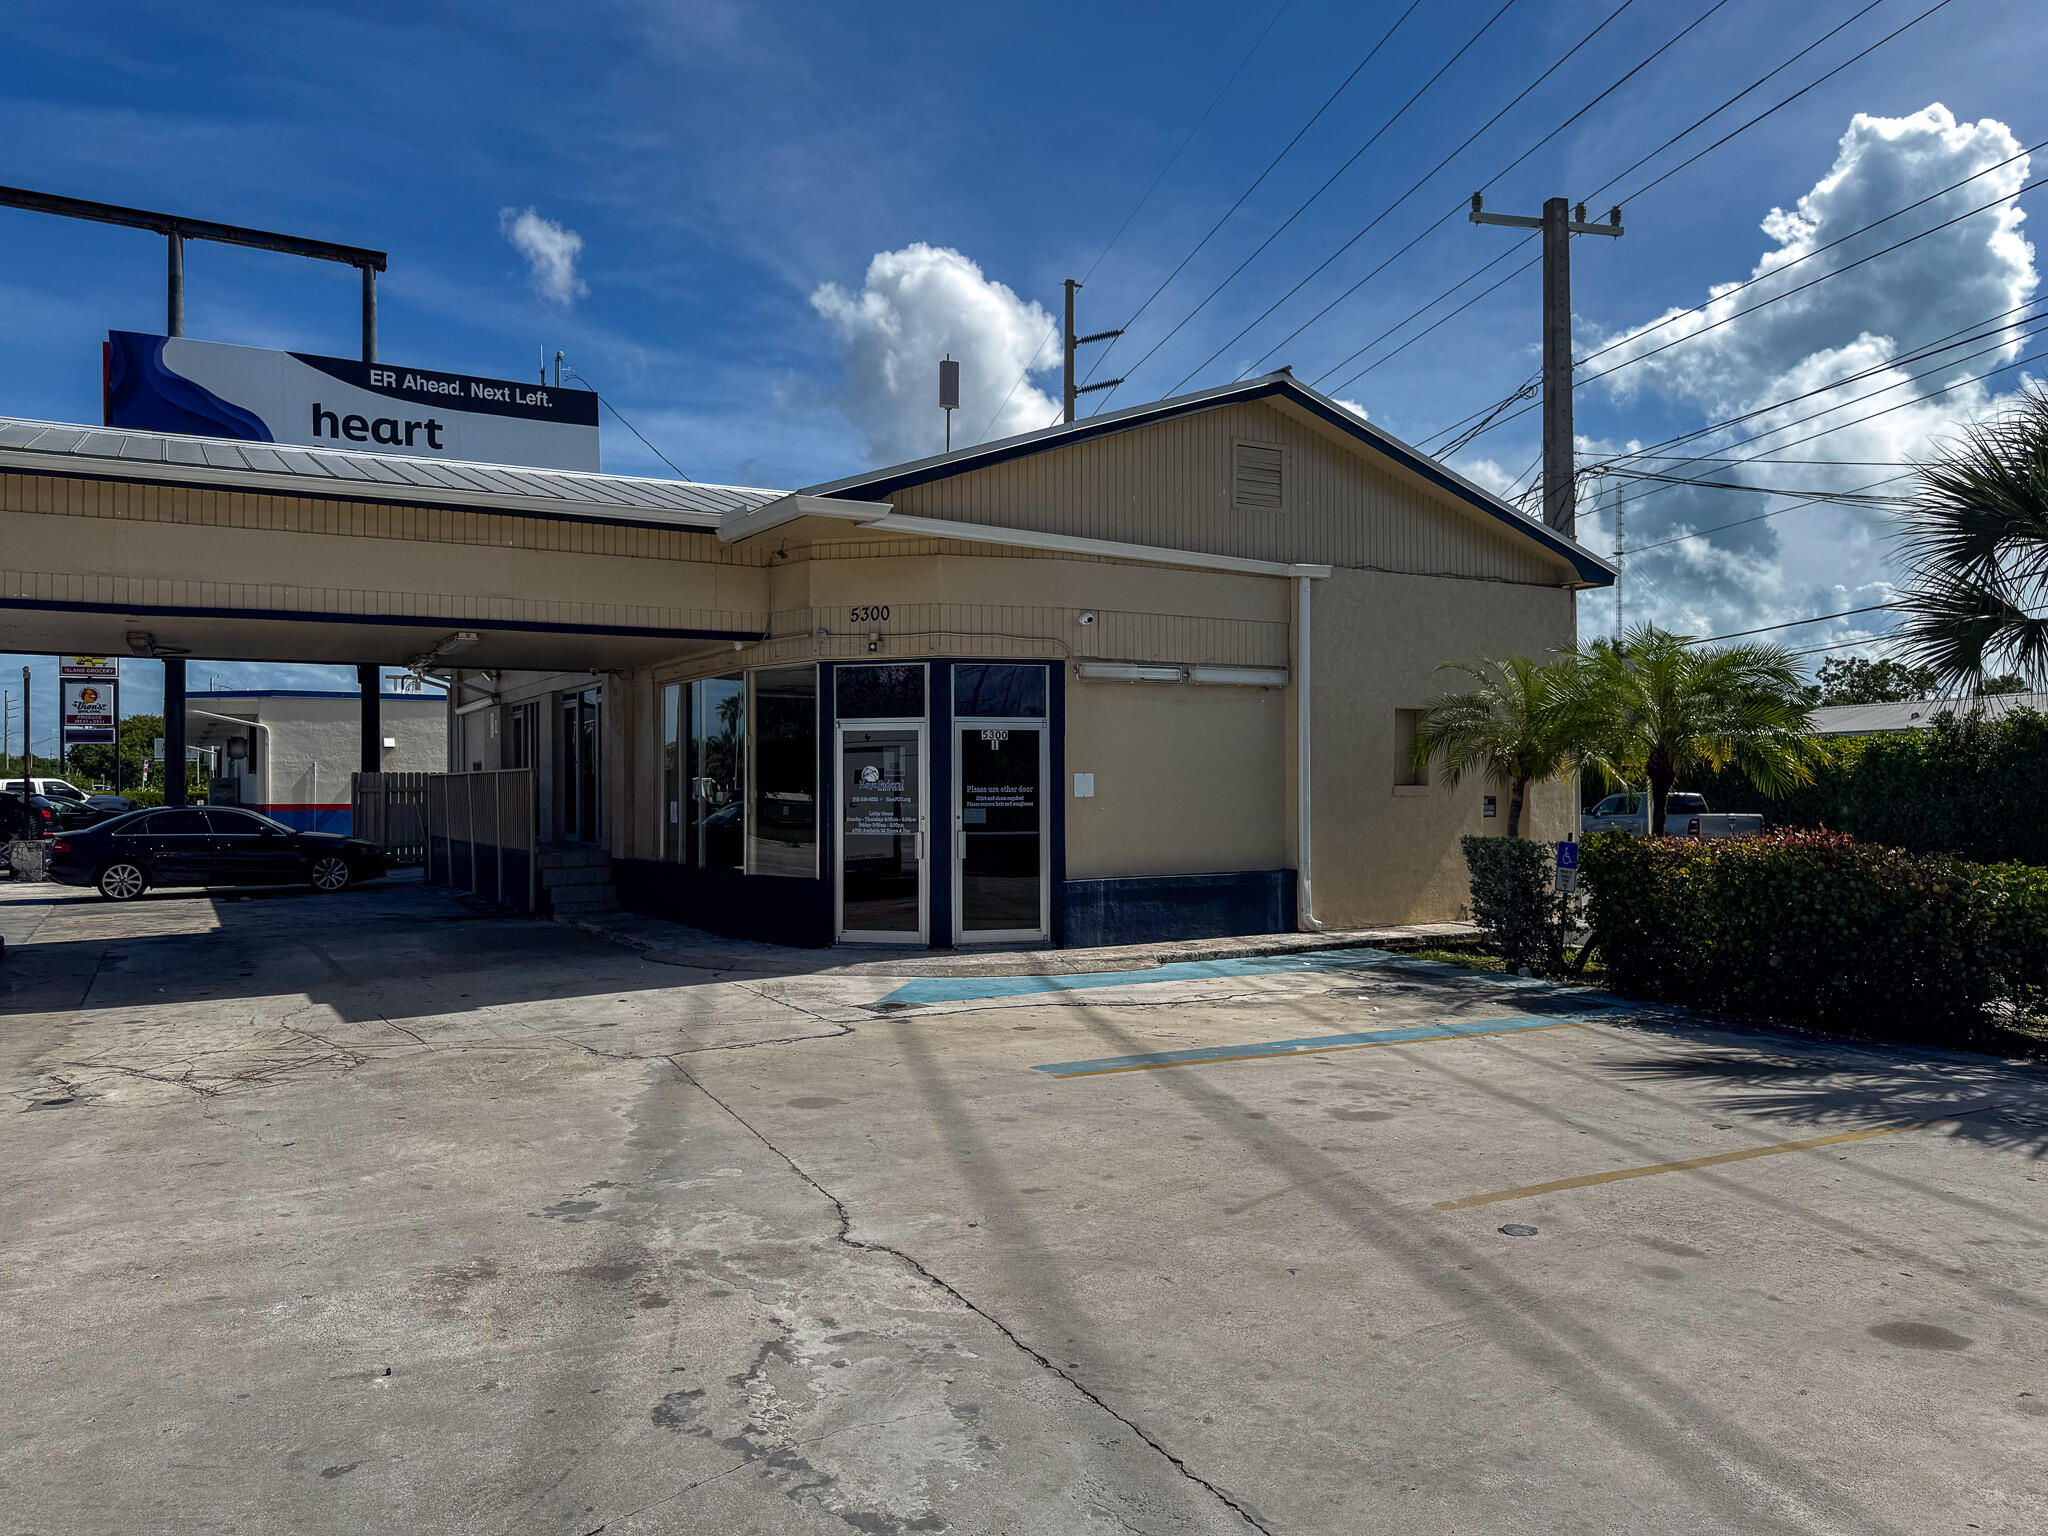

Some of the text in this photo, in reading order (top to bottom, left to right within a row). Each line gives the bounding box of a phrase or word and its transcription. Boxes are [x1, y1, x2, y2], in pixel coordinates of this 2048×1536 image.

[370, 369, 553, 408] ER Ahead. Next Left.
[312, 403, 443, 449] heart
[850, 605, 890, 622] 5300
[982, 730, 1008, 740] 5300
[966, 785, 987, 793] Please
[1000, 785, 1017, 793] other
[1018, 785, 1033, 793] door
